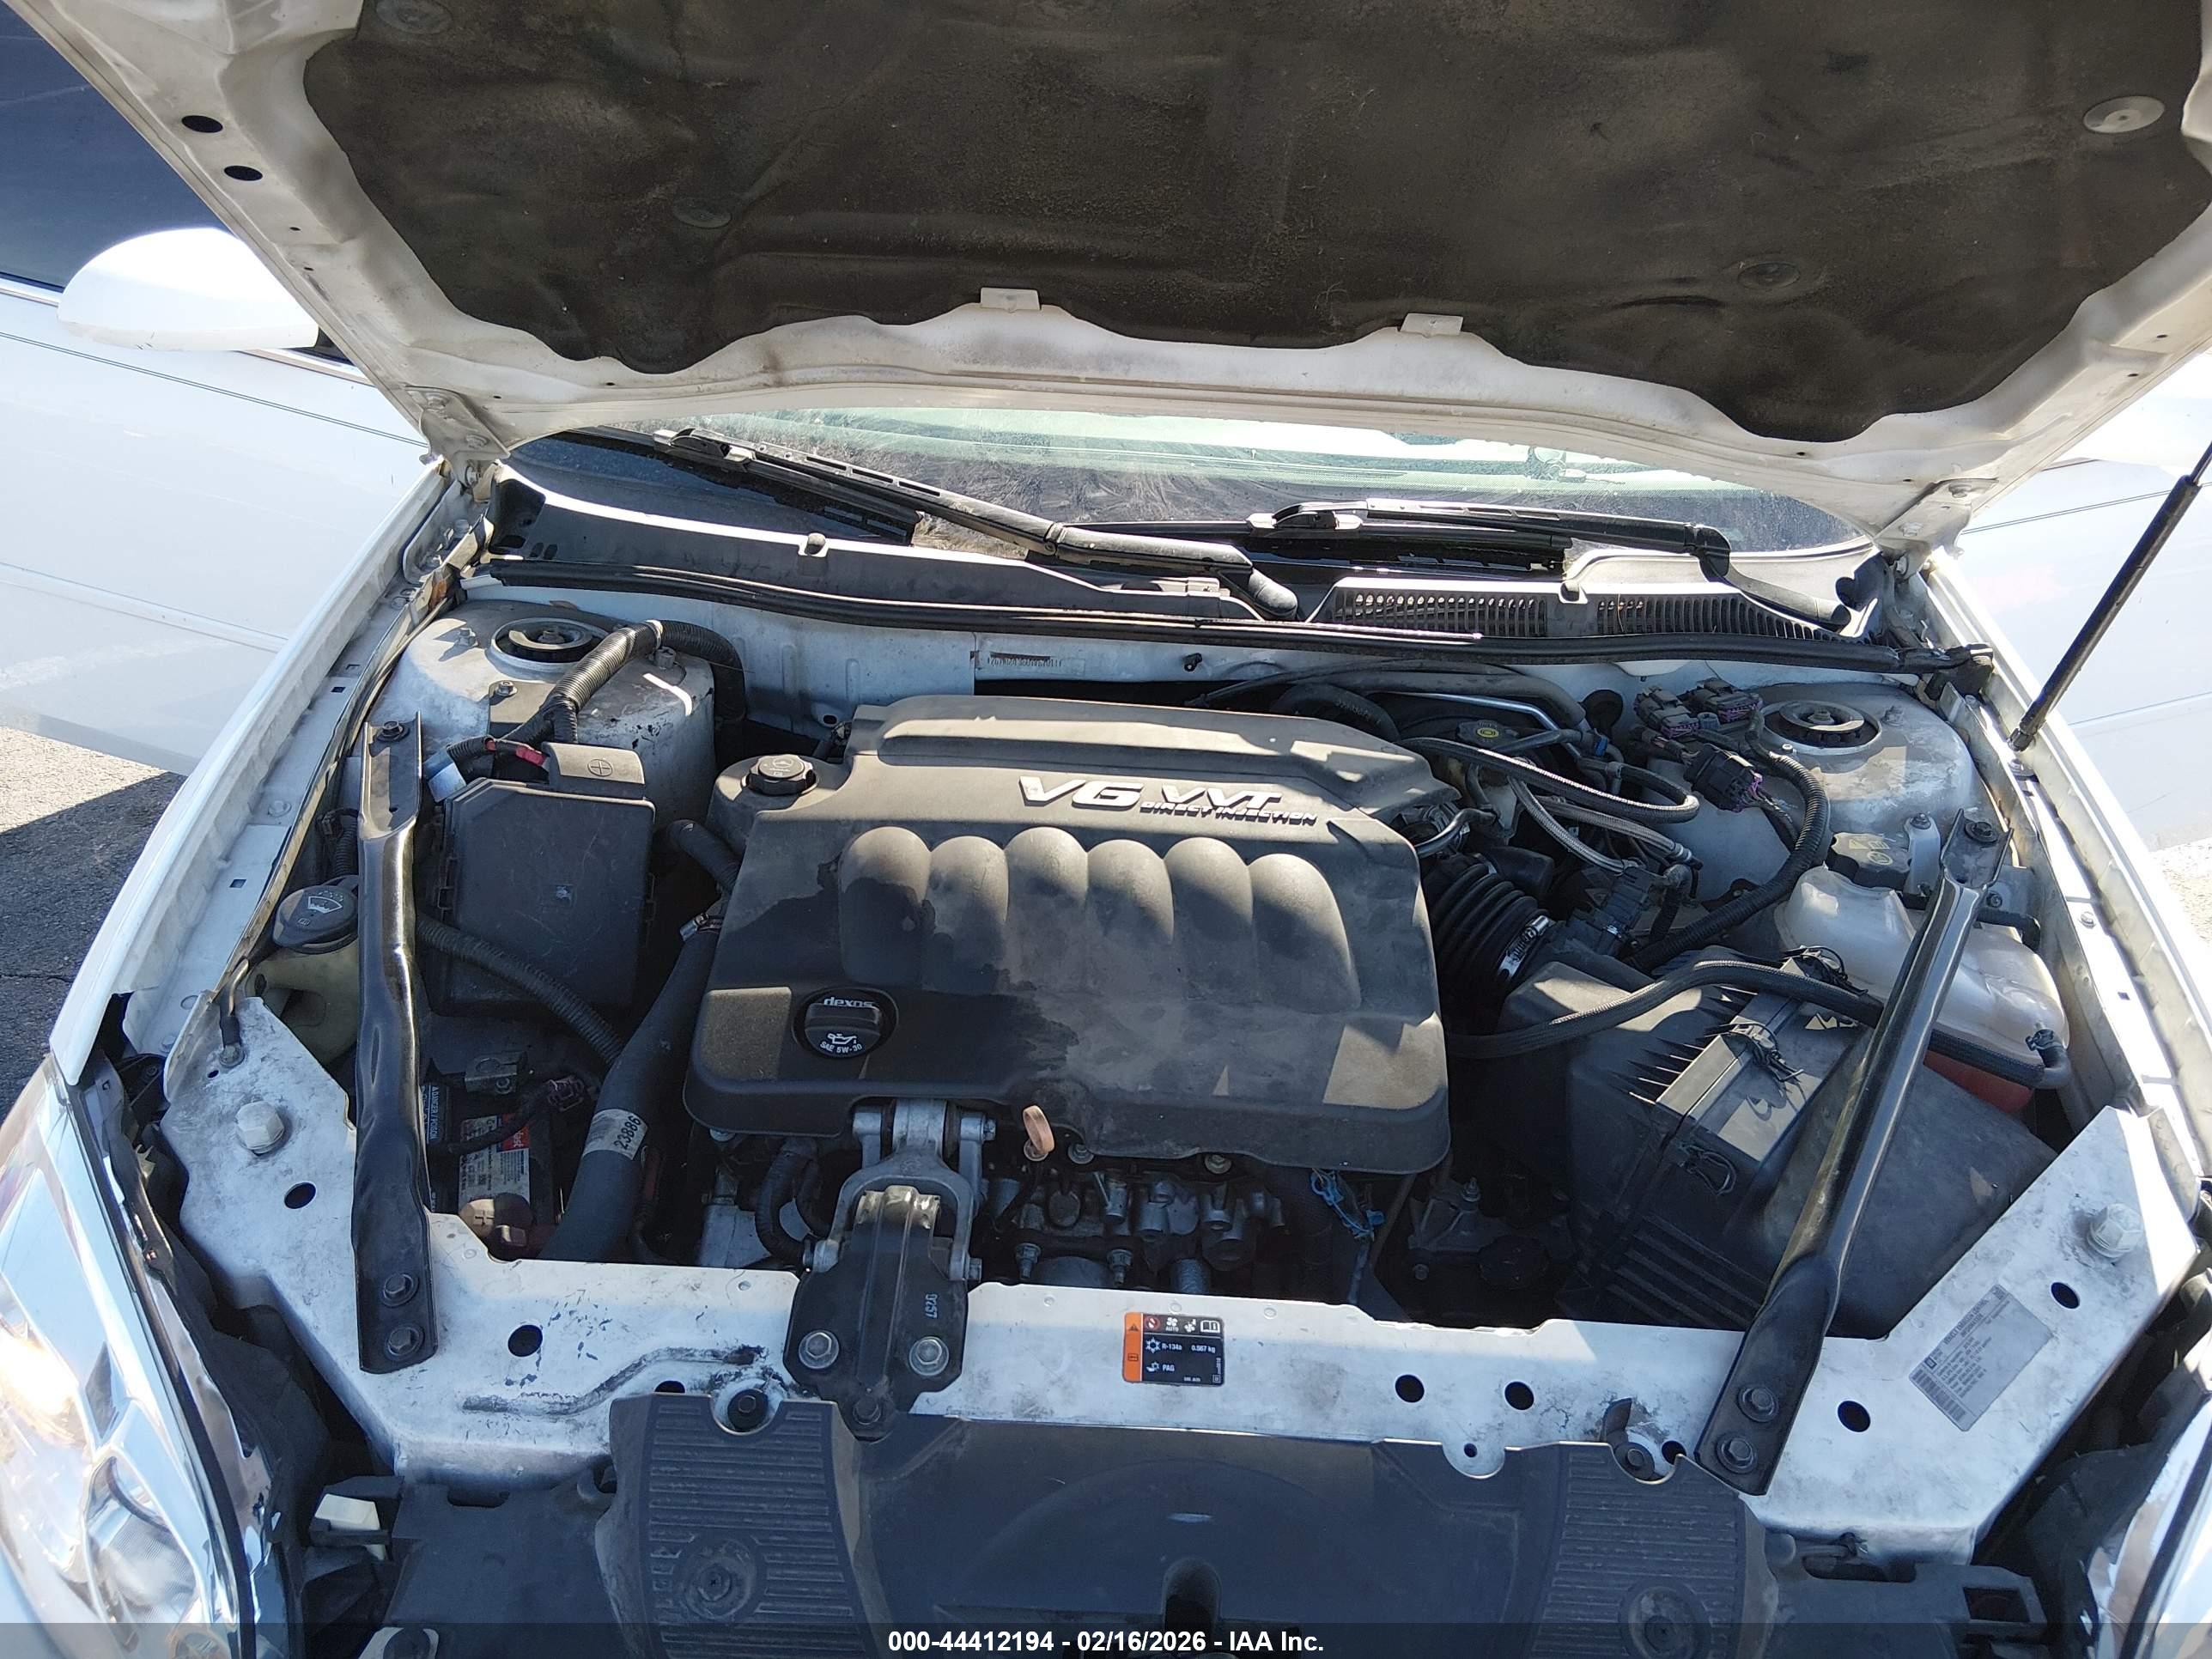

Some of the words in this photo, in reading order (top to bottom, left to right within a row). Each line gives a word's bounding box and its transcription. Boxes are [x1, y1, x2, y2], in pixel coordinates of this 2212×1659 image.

[1018, 775, 1144, 811] V6
[1162, 784, 1283, 810] VVT
[1139, 800, 1213, 818] DIRECT
[1215, 805, 1317, 827] INJECTION
[823, 996, 875, 1007] dexos
[819, 1041, 836, 1053] SAE
[836, 1043, 863, 1054] 5W-30
[613, 1115, 641, 1150] 23886
[1162, 1341, 1182, 1351] R-134a
[1207, 1346, 1216, 1354] kg
[1162, 1364, 1176, 1372] PAG
